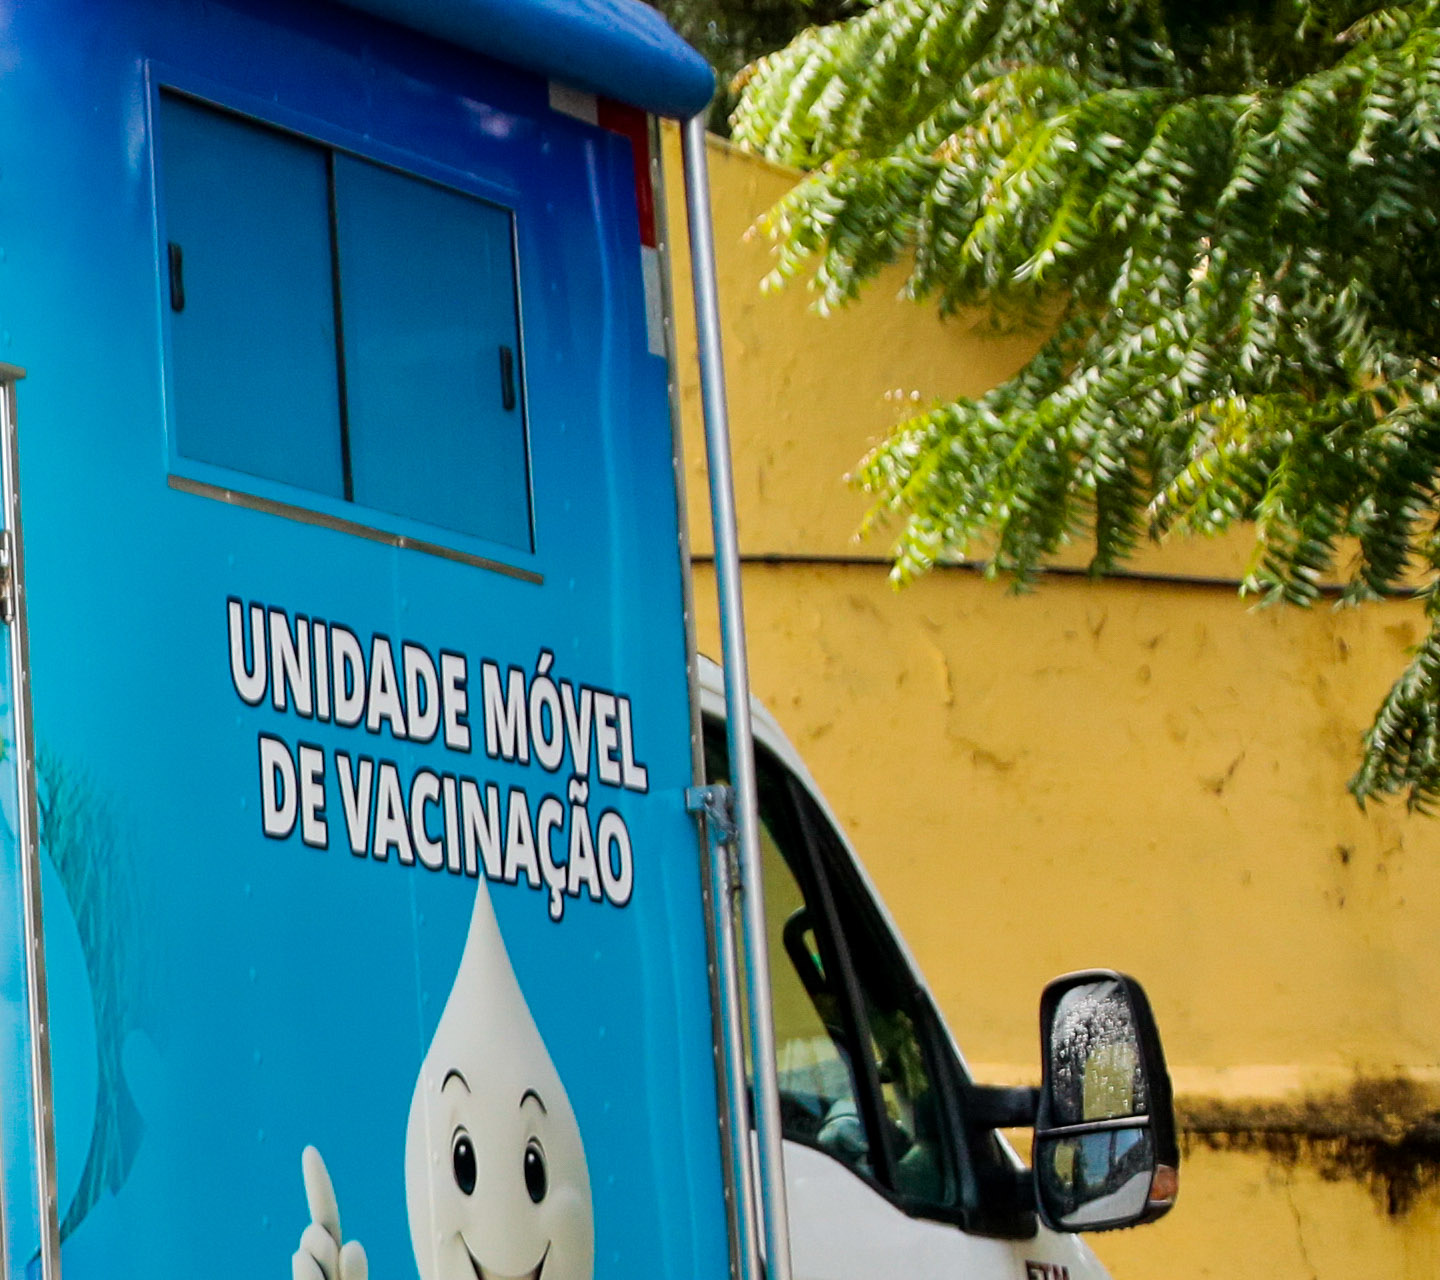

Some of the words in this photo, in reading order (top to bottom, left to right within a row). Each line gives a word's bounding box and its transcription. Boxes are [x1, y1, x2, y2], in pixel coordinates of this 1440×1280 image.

[227, 595, 471, 753] UNIDADE
[481, 647, 649, 793] MÓVEL
[258, 731, 329, 850] DE
[335, 750, 635, 922] VACINAÇÃO
